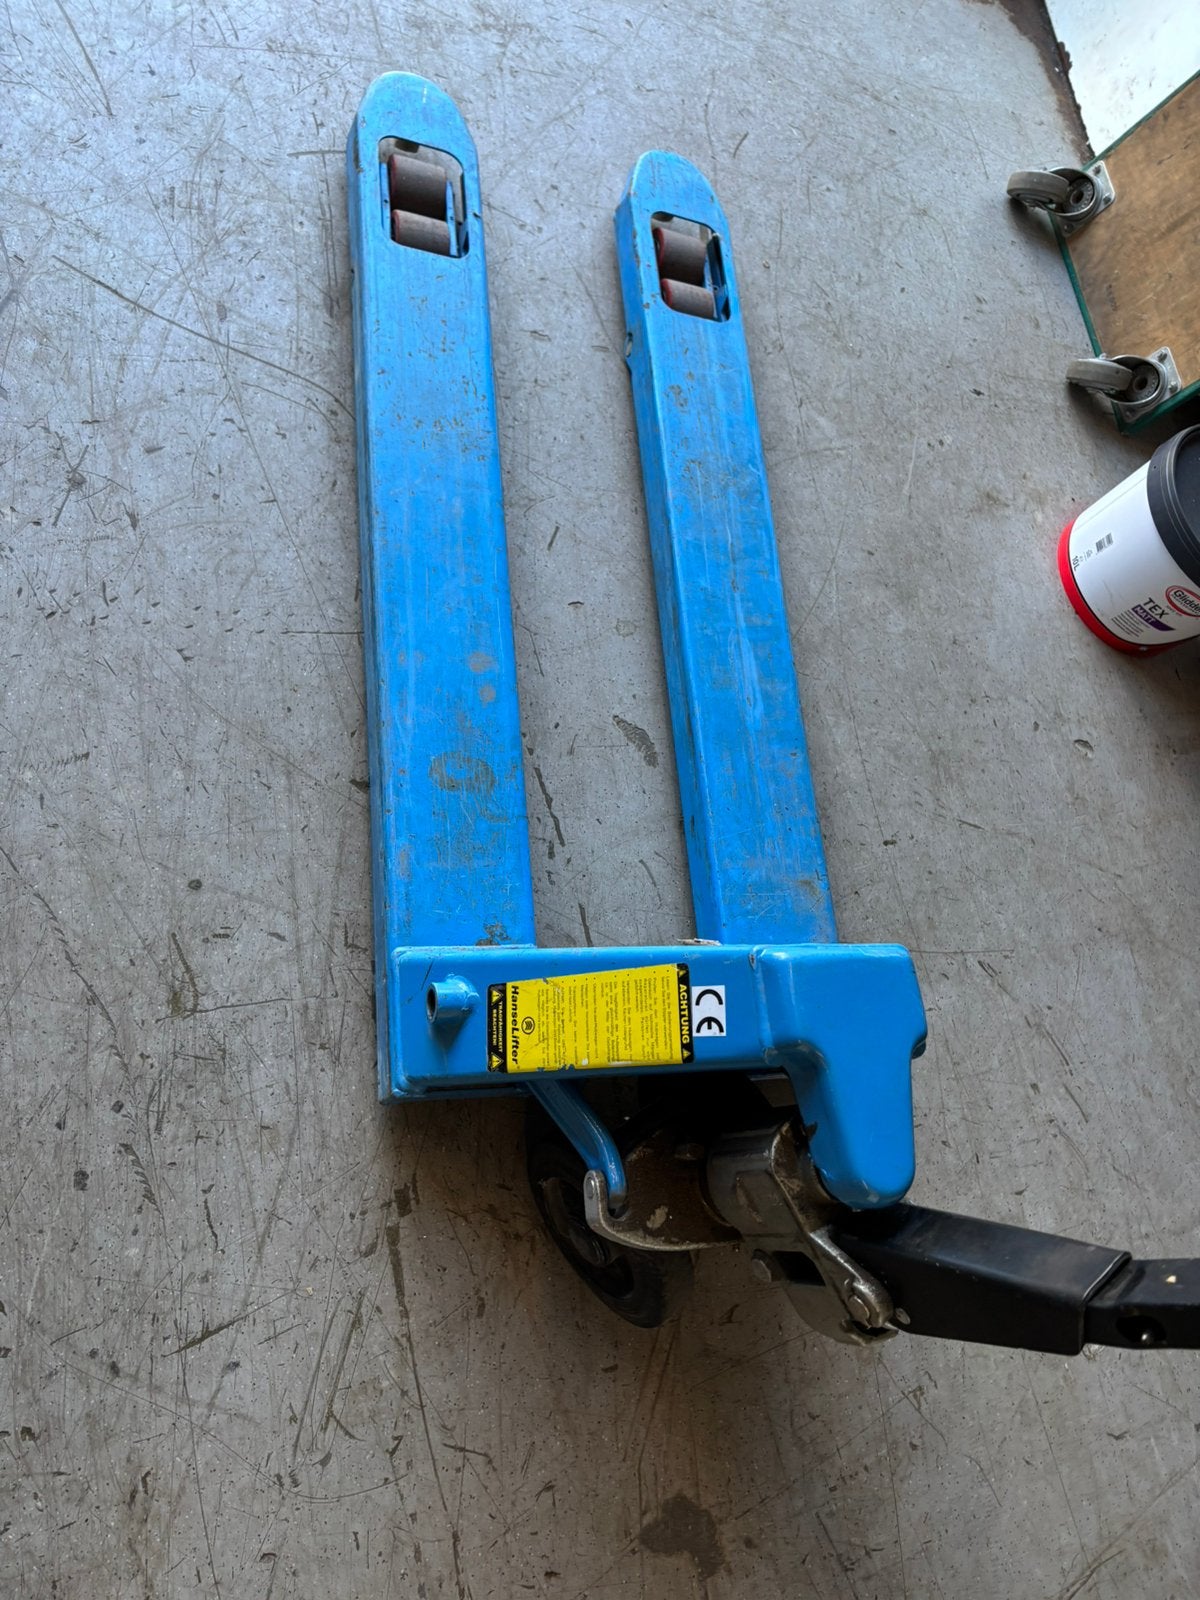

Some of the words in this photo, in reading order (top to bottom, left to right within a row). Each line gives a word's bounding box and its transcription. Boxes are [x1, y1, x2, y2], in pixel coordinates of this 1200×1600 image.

[1133, 606, 1156, 623] MATT
[1143, 597, 1169, 619] TEX
[511, 985, 520, 1065] HanseLifter
[679, 984, 690, 1044] ACHTUNG
[695, 988, 725, 1034] CE
